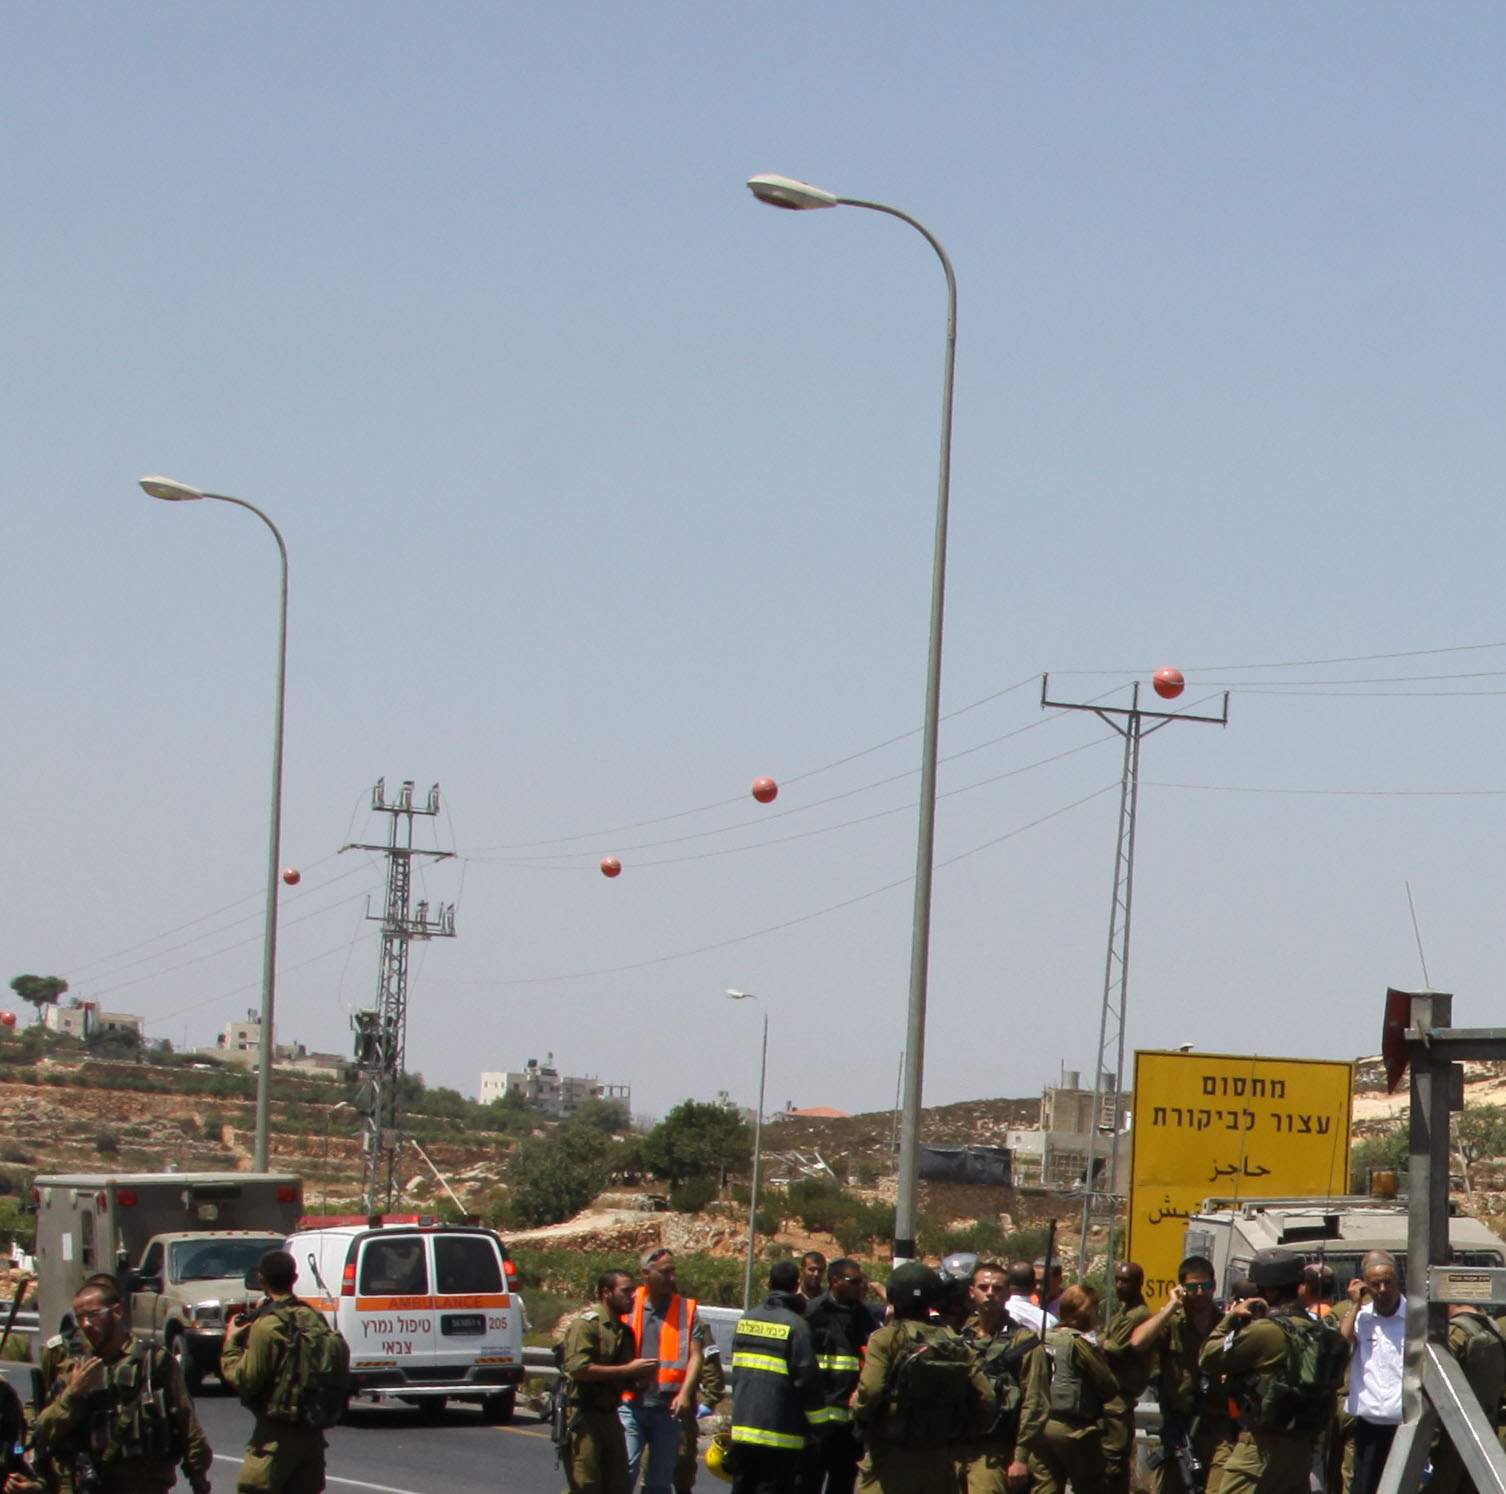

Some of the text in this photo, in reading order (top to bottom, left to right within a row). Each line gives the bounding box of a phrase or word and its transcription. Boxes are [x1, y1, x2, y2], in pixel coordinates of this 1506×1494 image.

[1202, 1076, 1286, 1099] מחסום
[1152, 1107, 1331, 1134] עצור לביקורת
[1208, 1156, 1271, 1182] حاجز
[1146, 1279, 1177, 1298] STO
[388, 1296, 483, 1309] AMBULANCE
[361, 1319, 393, 1338] נמרץ
[396, 1316, 431, 1334] טיפול
[488, 1317, 508, 1330] 205
[382, 1341, 412, 1355] צבאי
